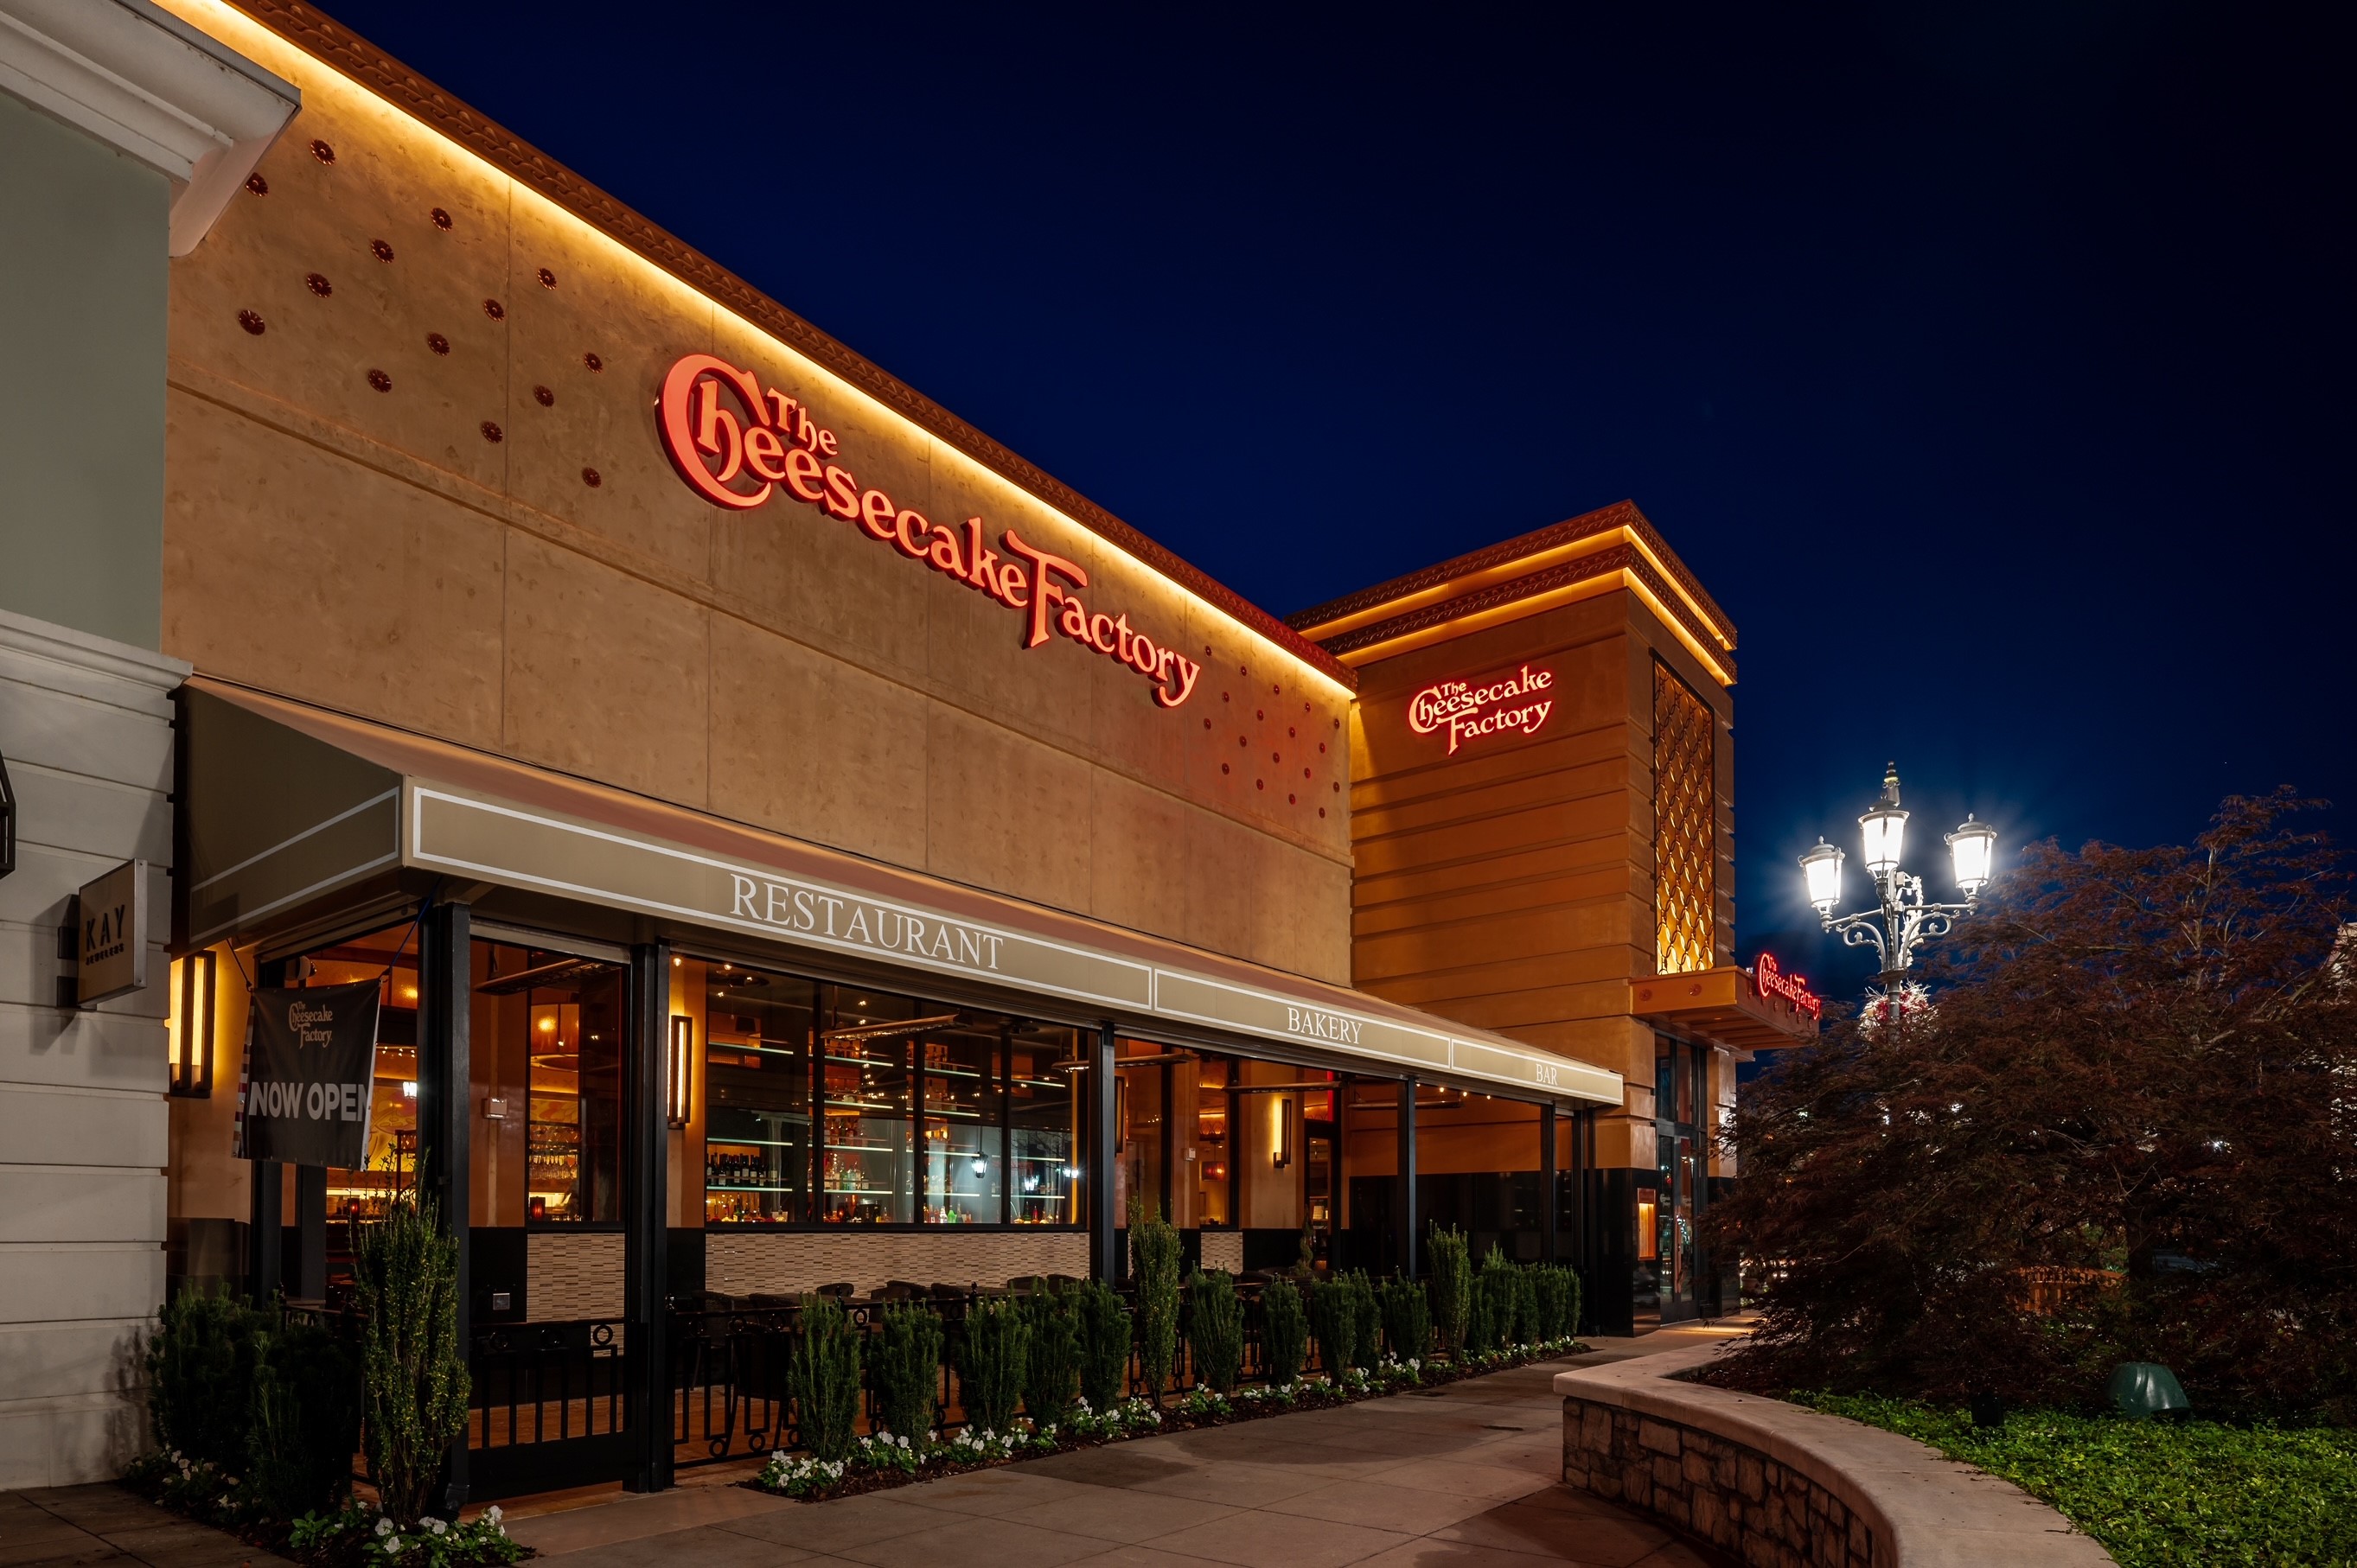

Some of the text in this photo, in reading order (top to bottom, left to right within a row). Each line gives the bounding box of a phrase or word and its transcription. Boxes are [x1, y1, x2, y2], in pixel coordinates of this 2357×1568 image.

[766, 386, 838, 457] The
[658, 354, 1201, 708] Cheesecake Factory
[1408, 666, 1552, 733] Cheesecake
[1440, 682, 1466, 697] The
[1436, 700, 1552, 755] Factory
[86, 904, 125, 952] KAY
[729, 873, 1004, 970] RESTAURANT
[86, 943, 124, 966] JEWELERS
[1759, 953, 1821, 1021] Cheesecake Factory
[289, 1003, 333, 1031] Cheesecake
[297, 1023, 333, 1049] Factory
[1287, 1007, 1363, 1044] BAKERY
[1536, 1063, 1558, 1086] BAR
[249, 1081, 303, 1119] NOW
